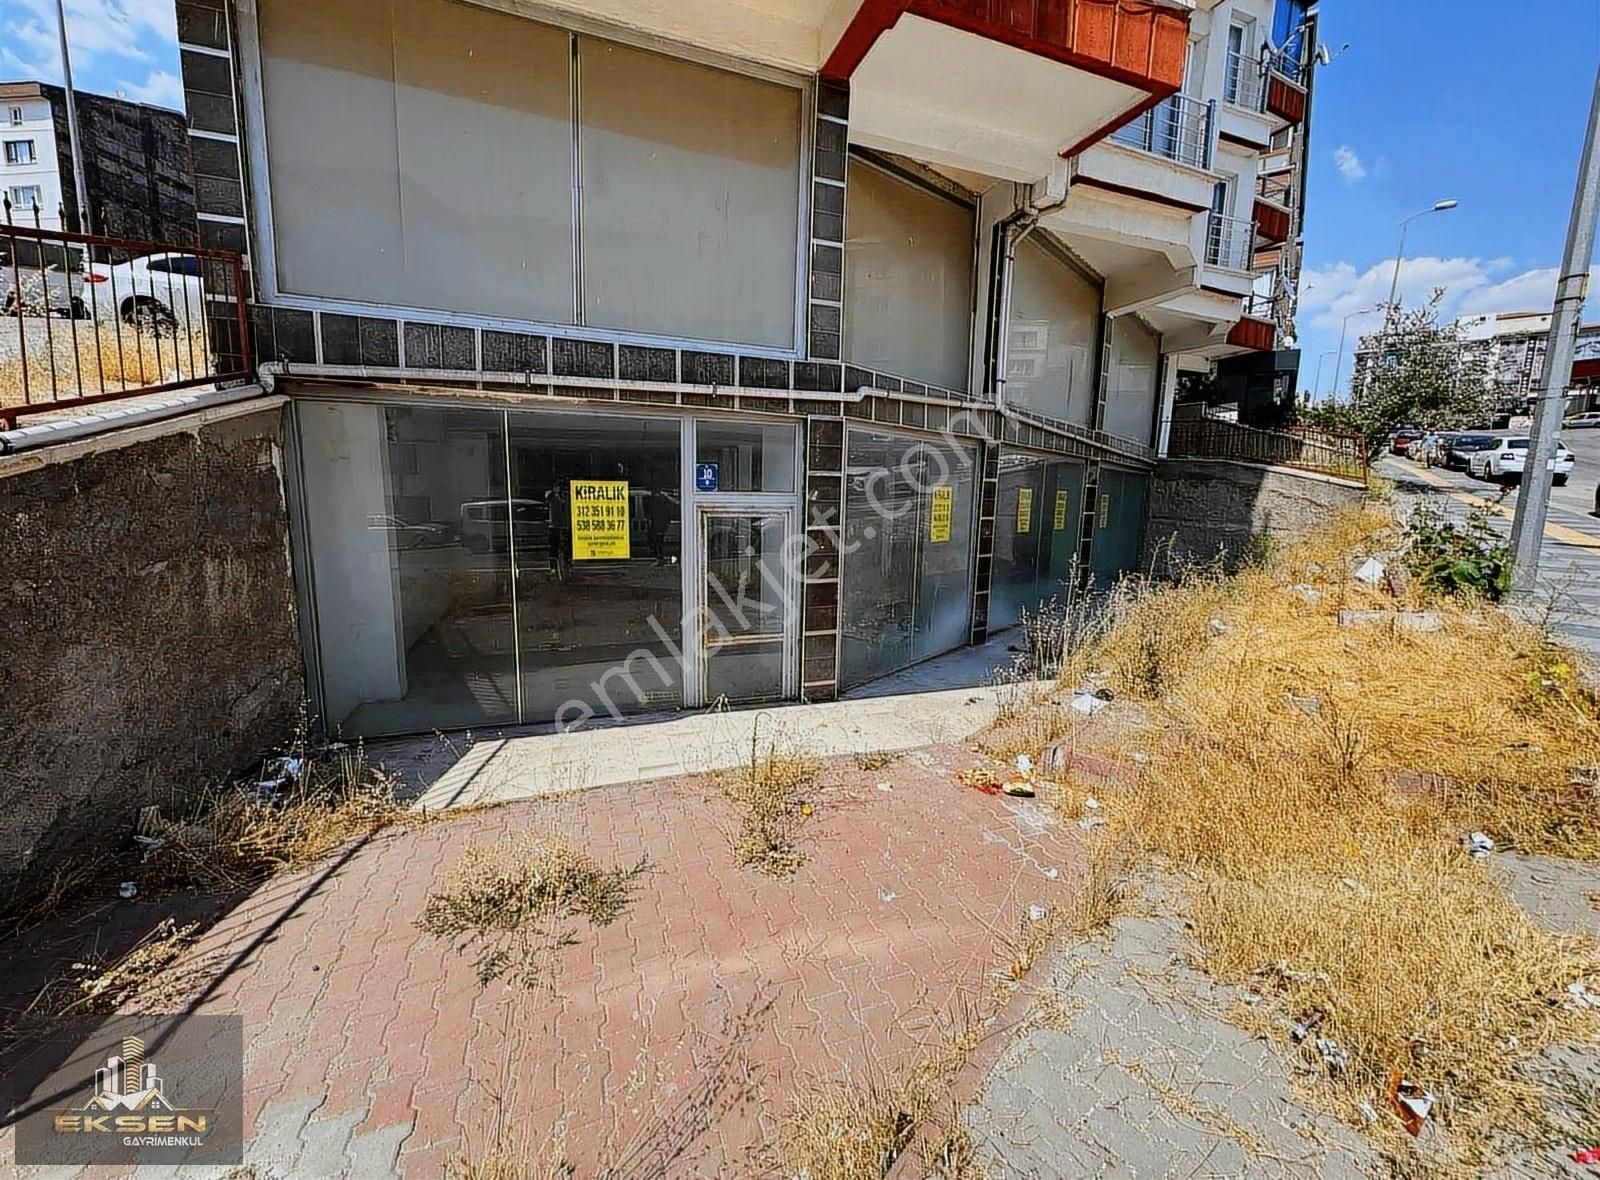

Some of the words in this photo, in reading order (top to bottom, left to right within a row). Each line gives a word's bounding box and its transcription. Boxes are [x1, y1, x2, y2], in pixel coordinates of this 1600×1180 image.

[576, 505, 590, 517] 312
[605, 505, 614, 517] 91
[616, 505, 625, 517] 10
[616, 519, 625, 532] 77
